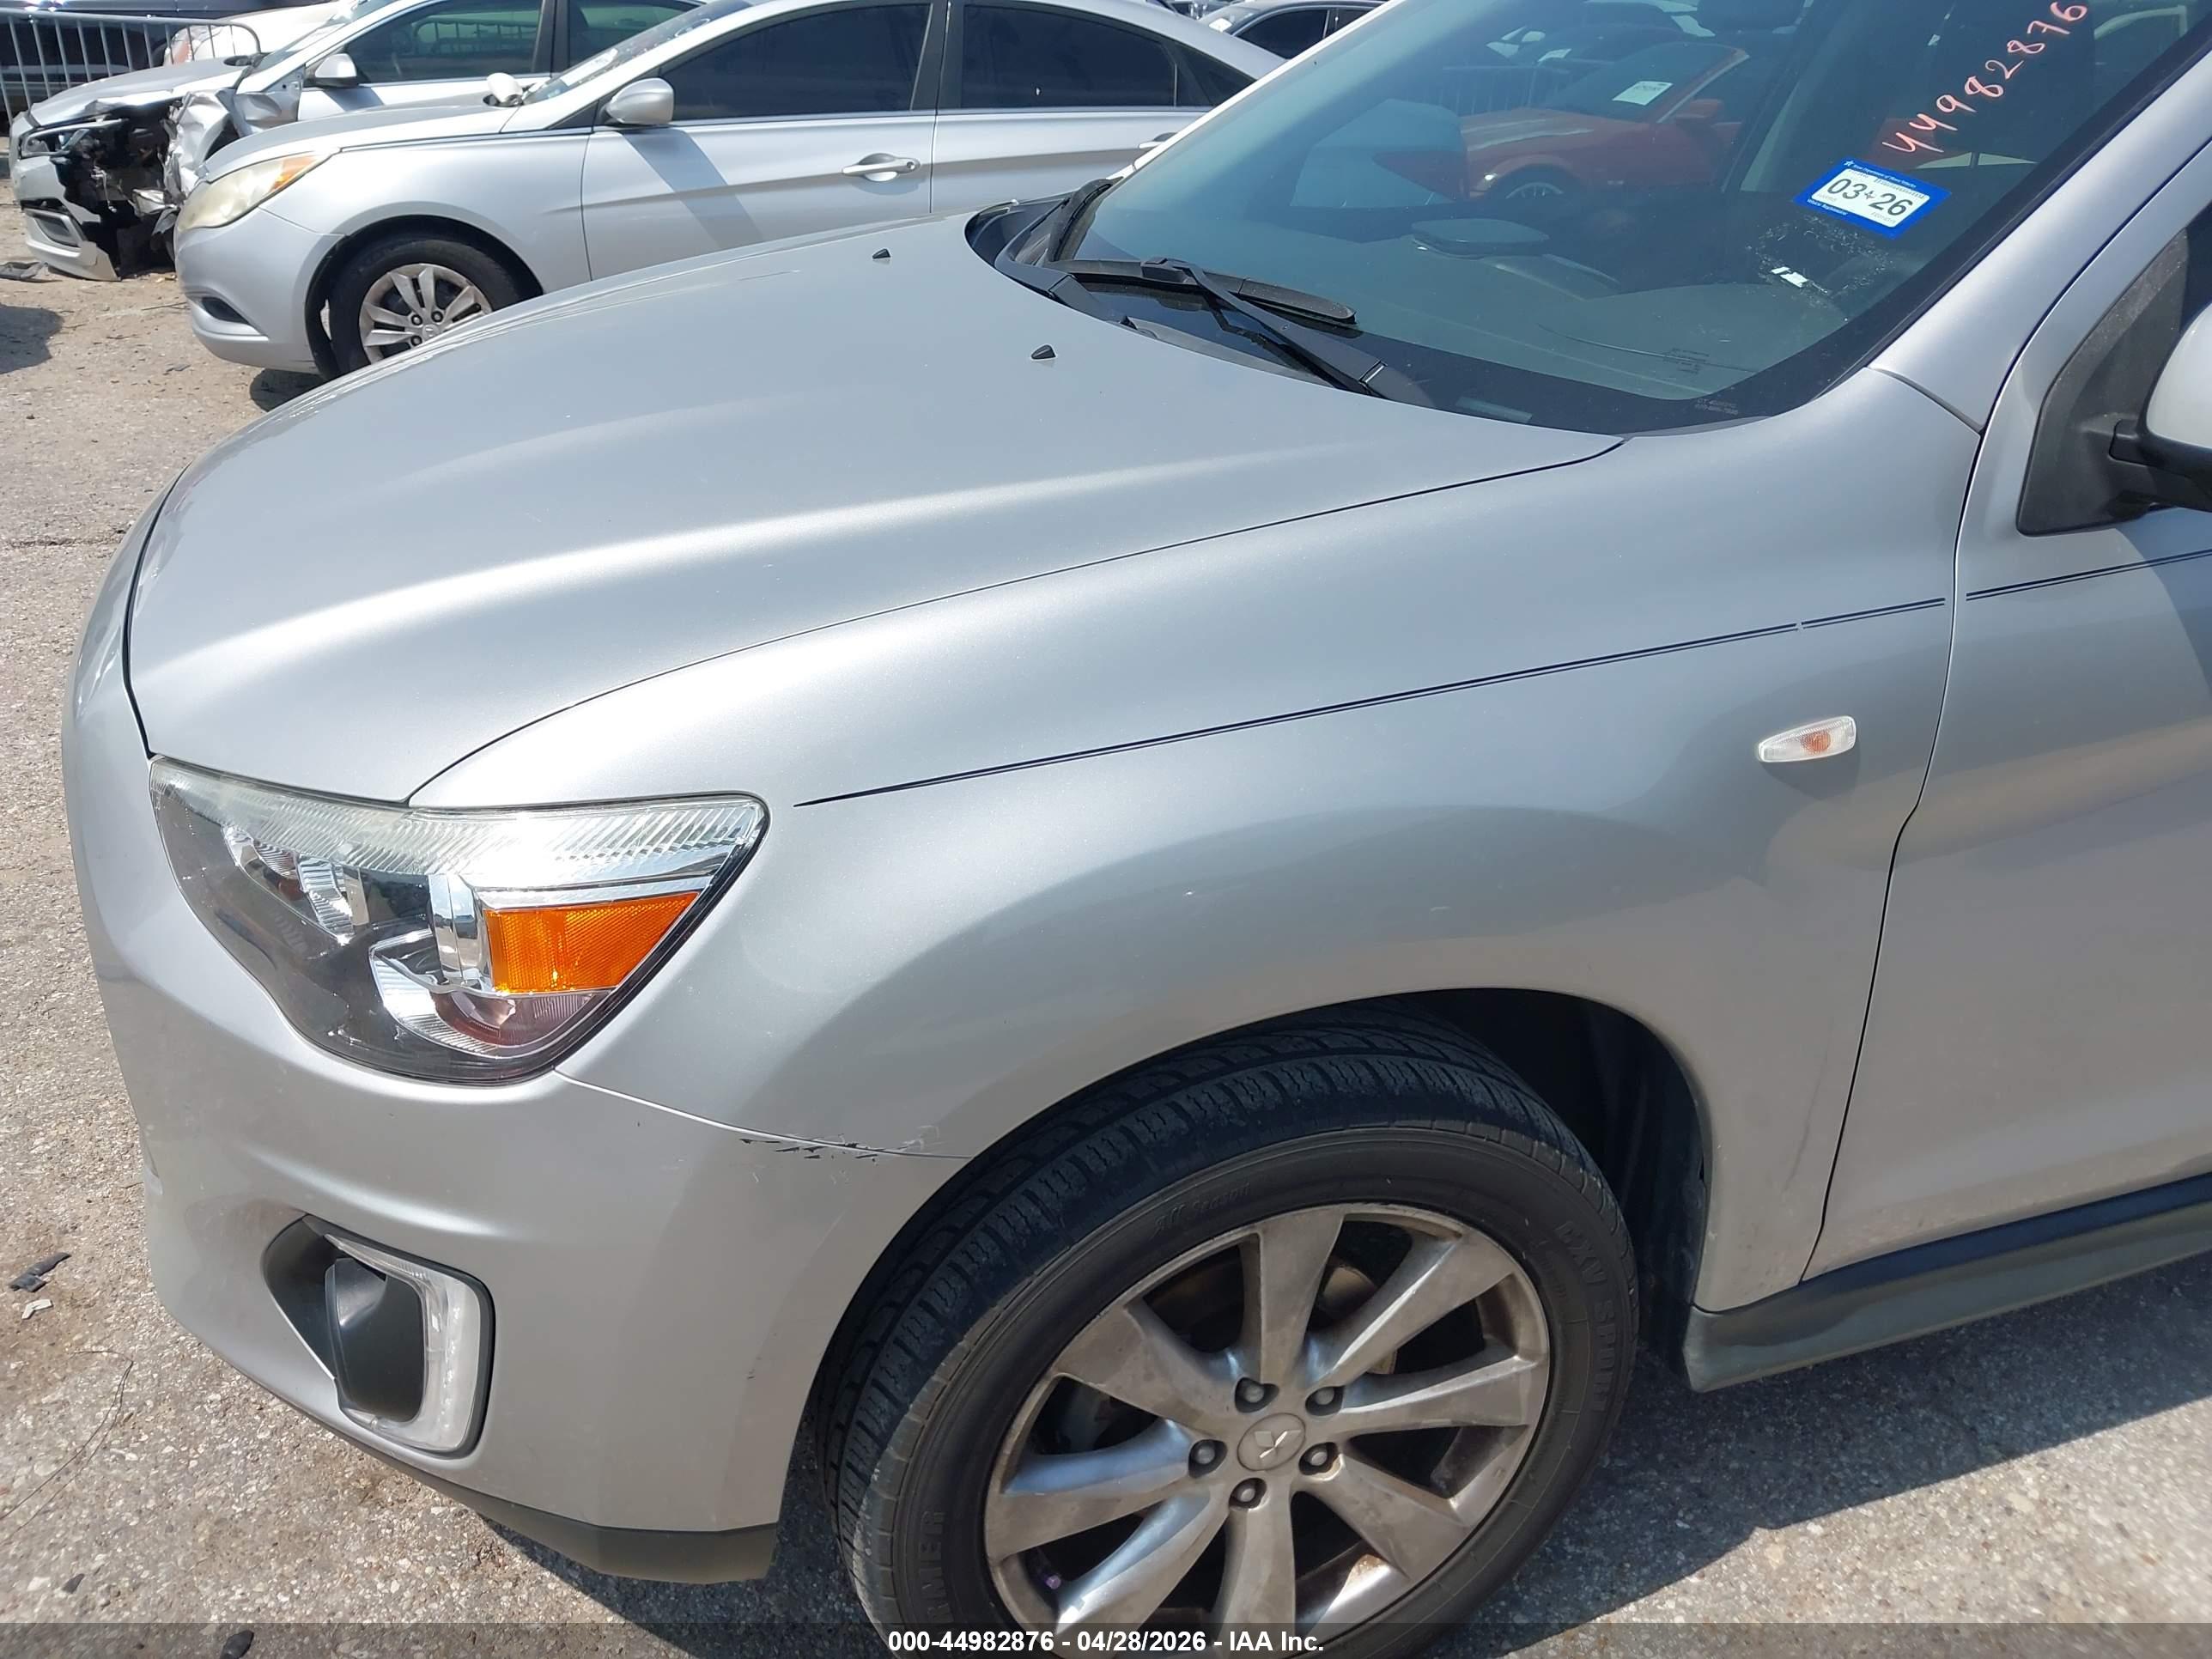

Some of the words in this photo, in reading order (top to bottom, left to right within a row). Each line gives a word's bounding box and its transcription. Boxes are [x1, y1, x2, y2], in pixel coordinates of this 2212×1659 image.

[1881, 1, 2088, 154] 44982876
[1826, 178, 1868, 200] 03
[1868, 193, 1913, 216] 26
